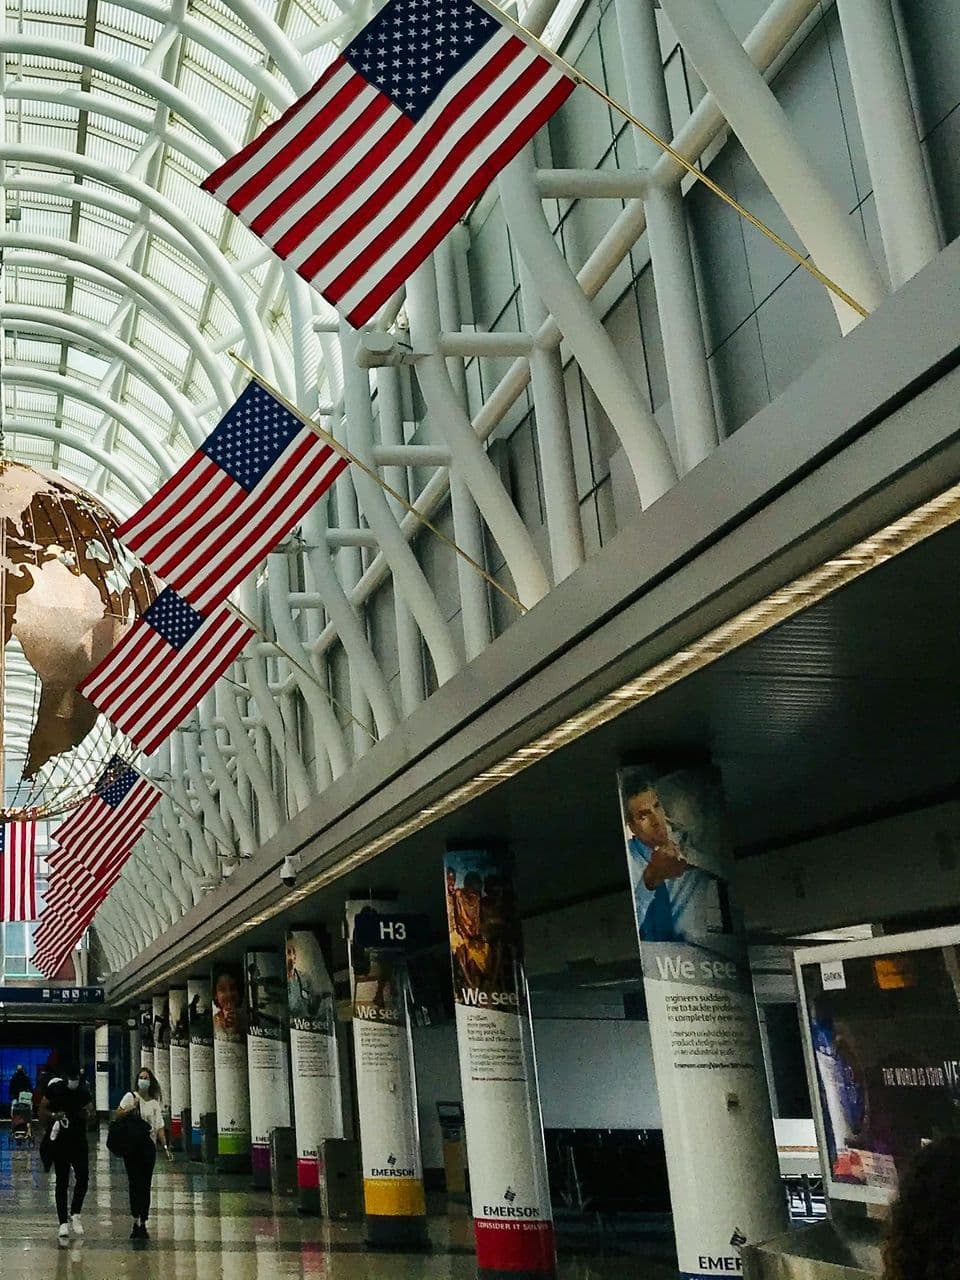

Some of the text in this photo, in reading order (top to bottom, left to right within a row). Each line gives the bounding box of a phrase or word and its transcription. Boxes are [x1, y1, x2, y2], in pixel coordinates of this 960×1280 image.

[379, 922, 406, 940] H3
[656, 956, 737, 979] We see
[461, 987, 520, 1006] We see
[664, 994, 699, 1004] engineers
[357, 1005, 399, 1020] We see
[680, 1004, 688, 1012] to
[688, 1004, 712, 1012] tackle
[294, 1018, 311, 1030] We
[675, 1014, 717, 1023] completely
[882, 1067, 895, 1087] THE
[895, 1067, 918, 1087] WORLD
[917, 1067, 926, 1087] IS
[926, 1066, 945, 1087] YOUR
[371, 1169, 415, 1177] EMERSON
[483, 1205, 540, 1218] EMERSON
[477, 1221, 511, 1231] CONSIDER
